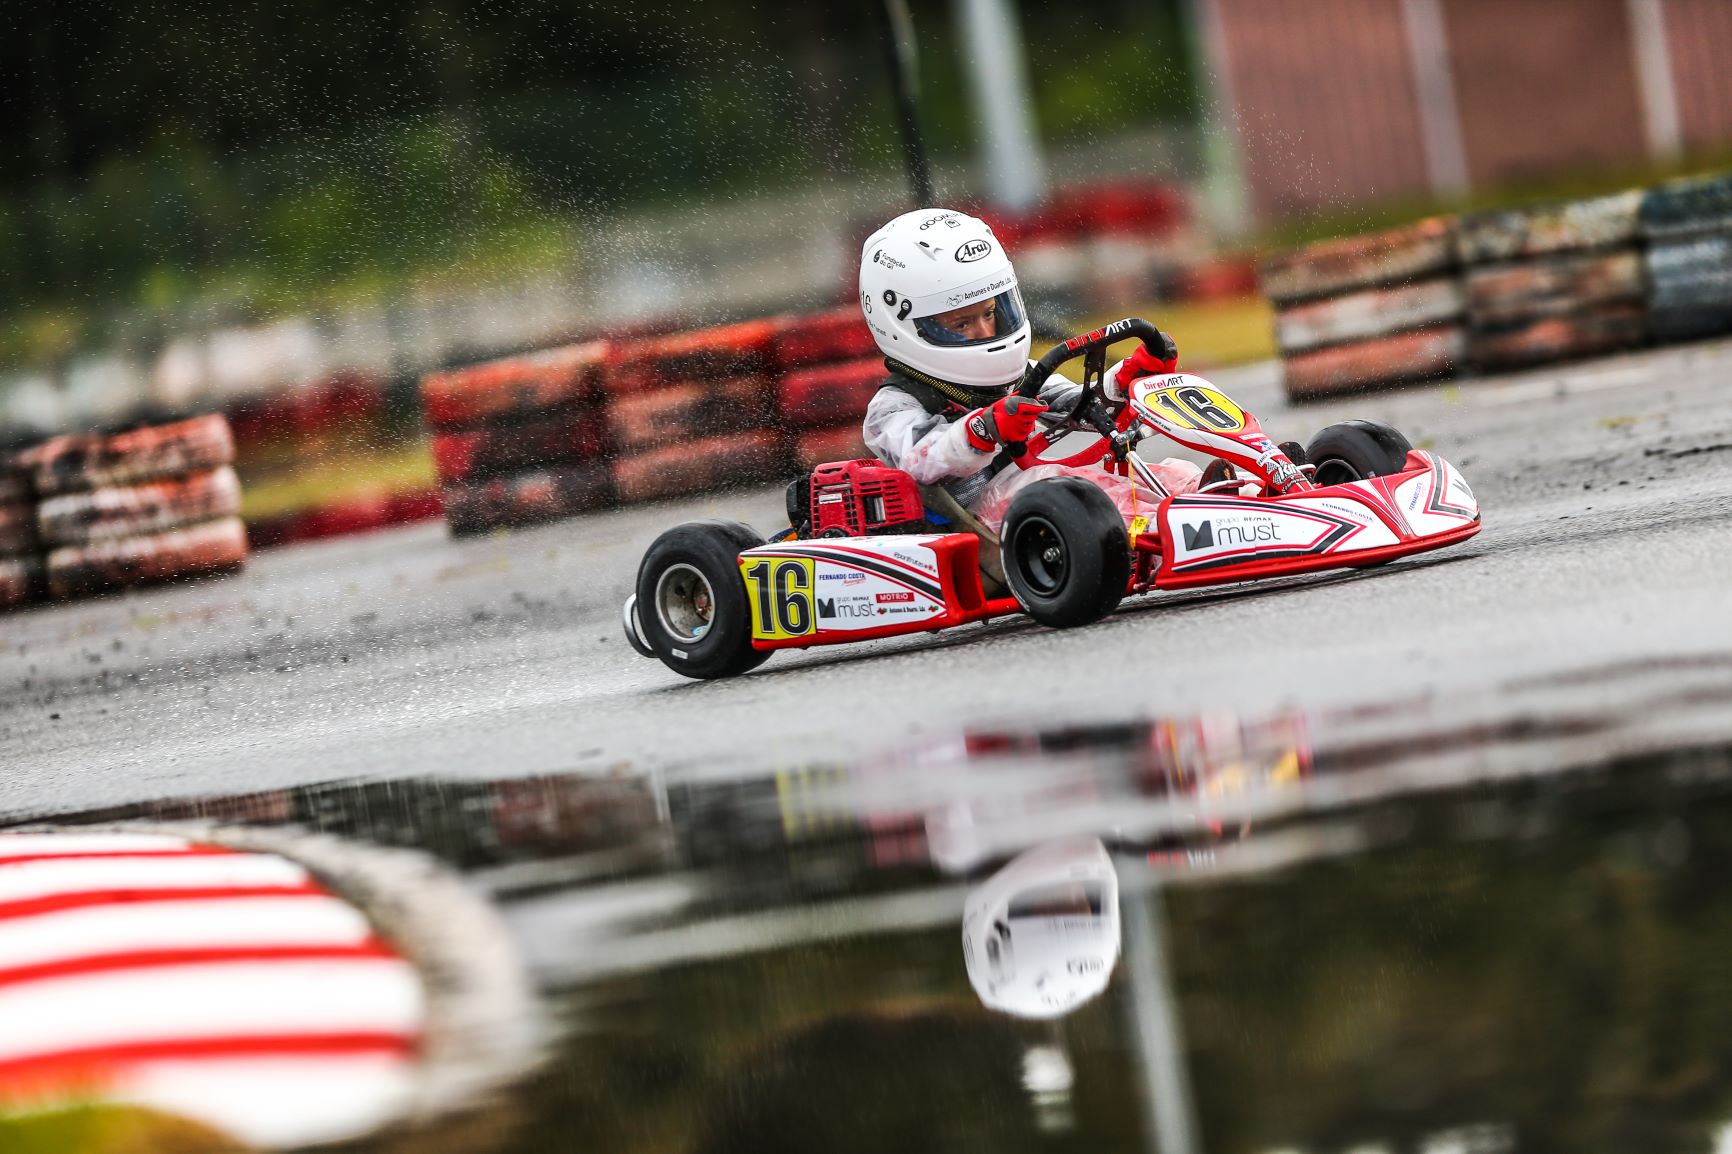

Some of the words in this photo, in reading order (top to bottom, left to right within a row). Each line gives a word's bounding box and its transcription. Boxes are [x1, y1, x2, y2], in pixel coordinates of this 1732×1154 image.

[958, 240, 988, 261] Arai
[879, 259, 886, 267] do
[881, 252, 906, 269] Fundação
[964, 288, 987, 300] Antunes
[989, 279, 1005, 291] Duarte
[861, 289, 873, 314] 16
[1143, 375, 1184, 390] birelART
[1155, 386, 1241, 432] 16
[1215, 517, 1240, 527] grupo
[1217, 522, 1282, 546] must
[819, 573, 847, 581] FERNANDO
[847, 572, 866, 580] COSTA
[747, 560, 812, 636] 16
[838, 601, 876, 618] must
